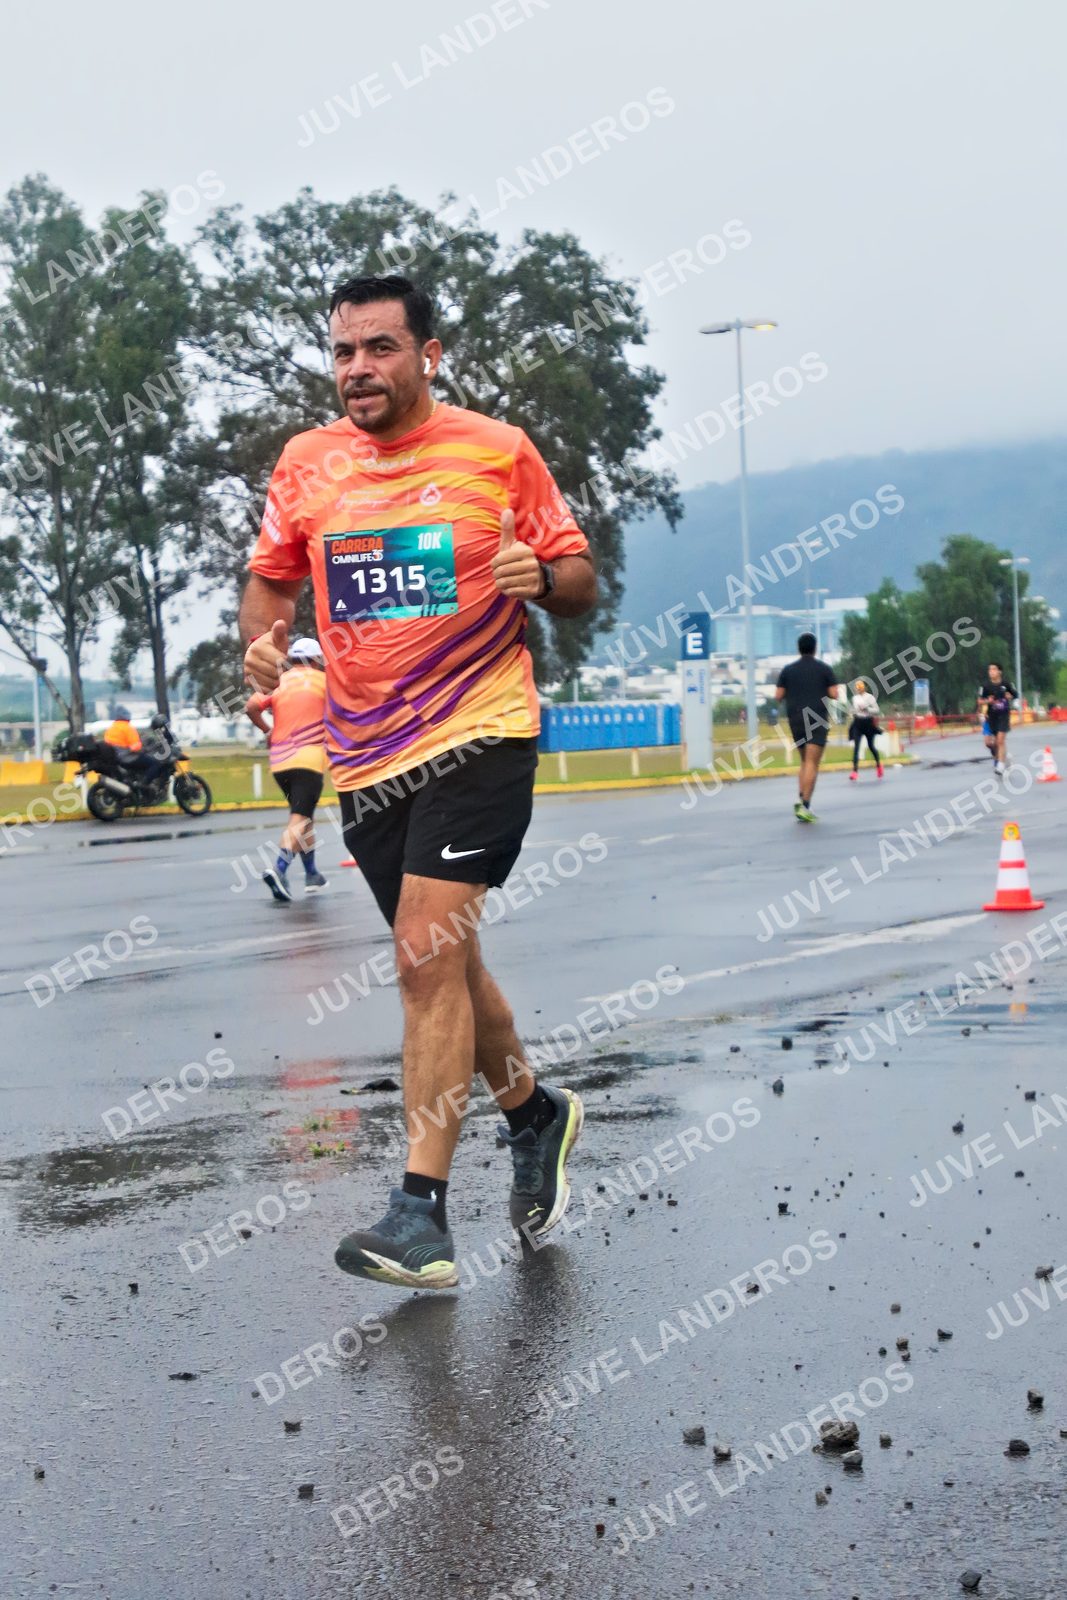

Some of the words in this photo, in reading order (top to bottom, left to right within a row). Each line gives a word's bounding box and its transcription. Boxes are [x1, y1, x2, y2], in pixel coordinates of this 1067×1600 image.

[331, 536, 384, 554] CARRERA
[417, 532, 443, 551] 10K
[351, 565, 427, 595] 1315
[687, 632, 704, 655] E
